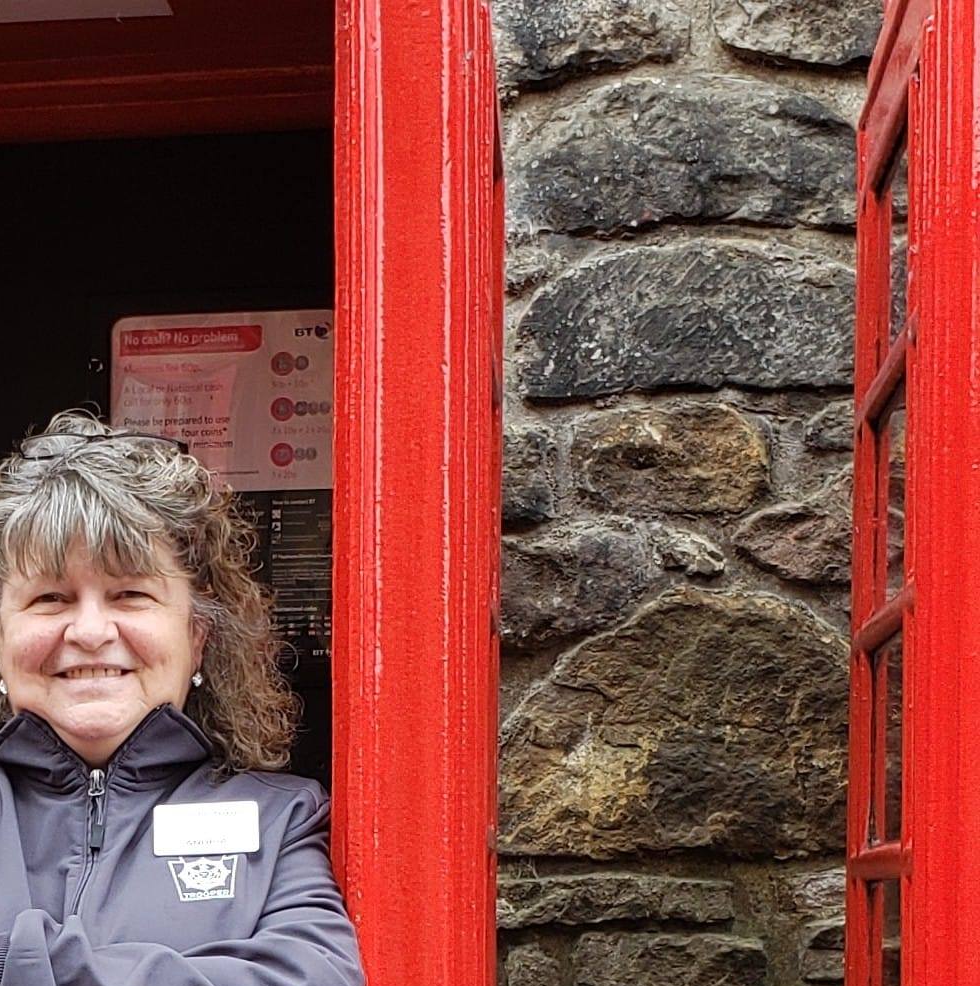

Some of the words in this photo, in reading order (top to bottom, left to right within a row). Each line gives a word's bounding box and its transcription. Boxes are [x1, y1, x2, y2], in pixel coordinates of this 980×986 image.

[294, 327, 313, 337] BT
[124, 331, 139, 345] No
[141, 331, 172, 345] cash?
[174, 331, 190, 344] No
[192, 330, 238, 345] problem
[123, 417, 150, 426] Please
[152, 416, 163, 425] be
[164, 415, 203, 426] prepared
[205, 416, 214, 424] to
[215, 416, 231, 424] use
[181, 428, 200, 437] four
